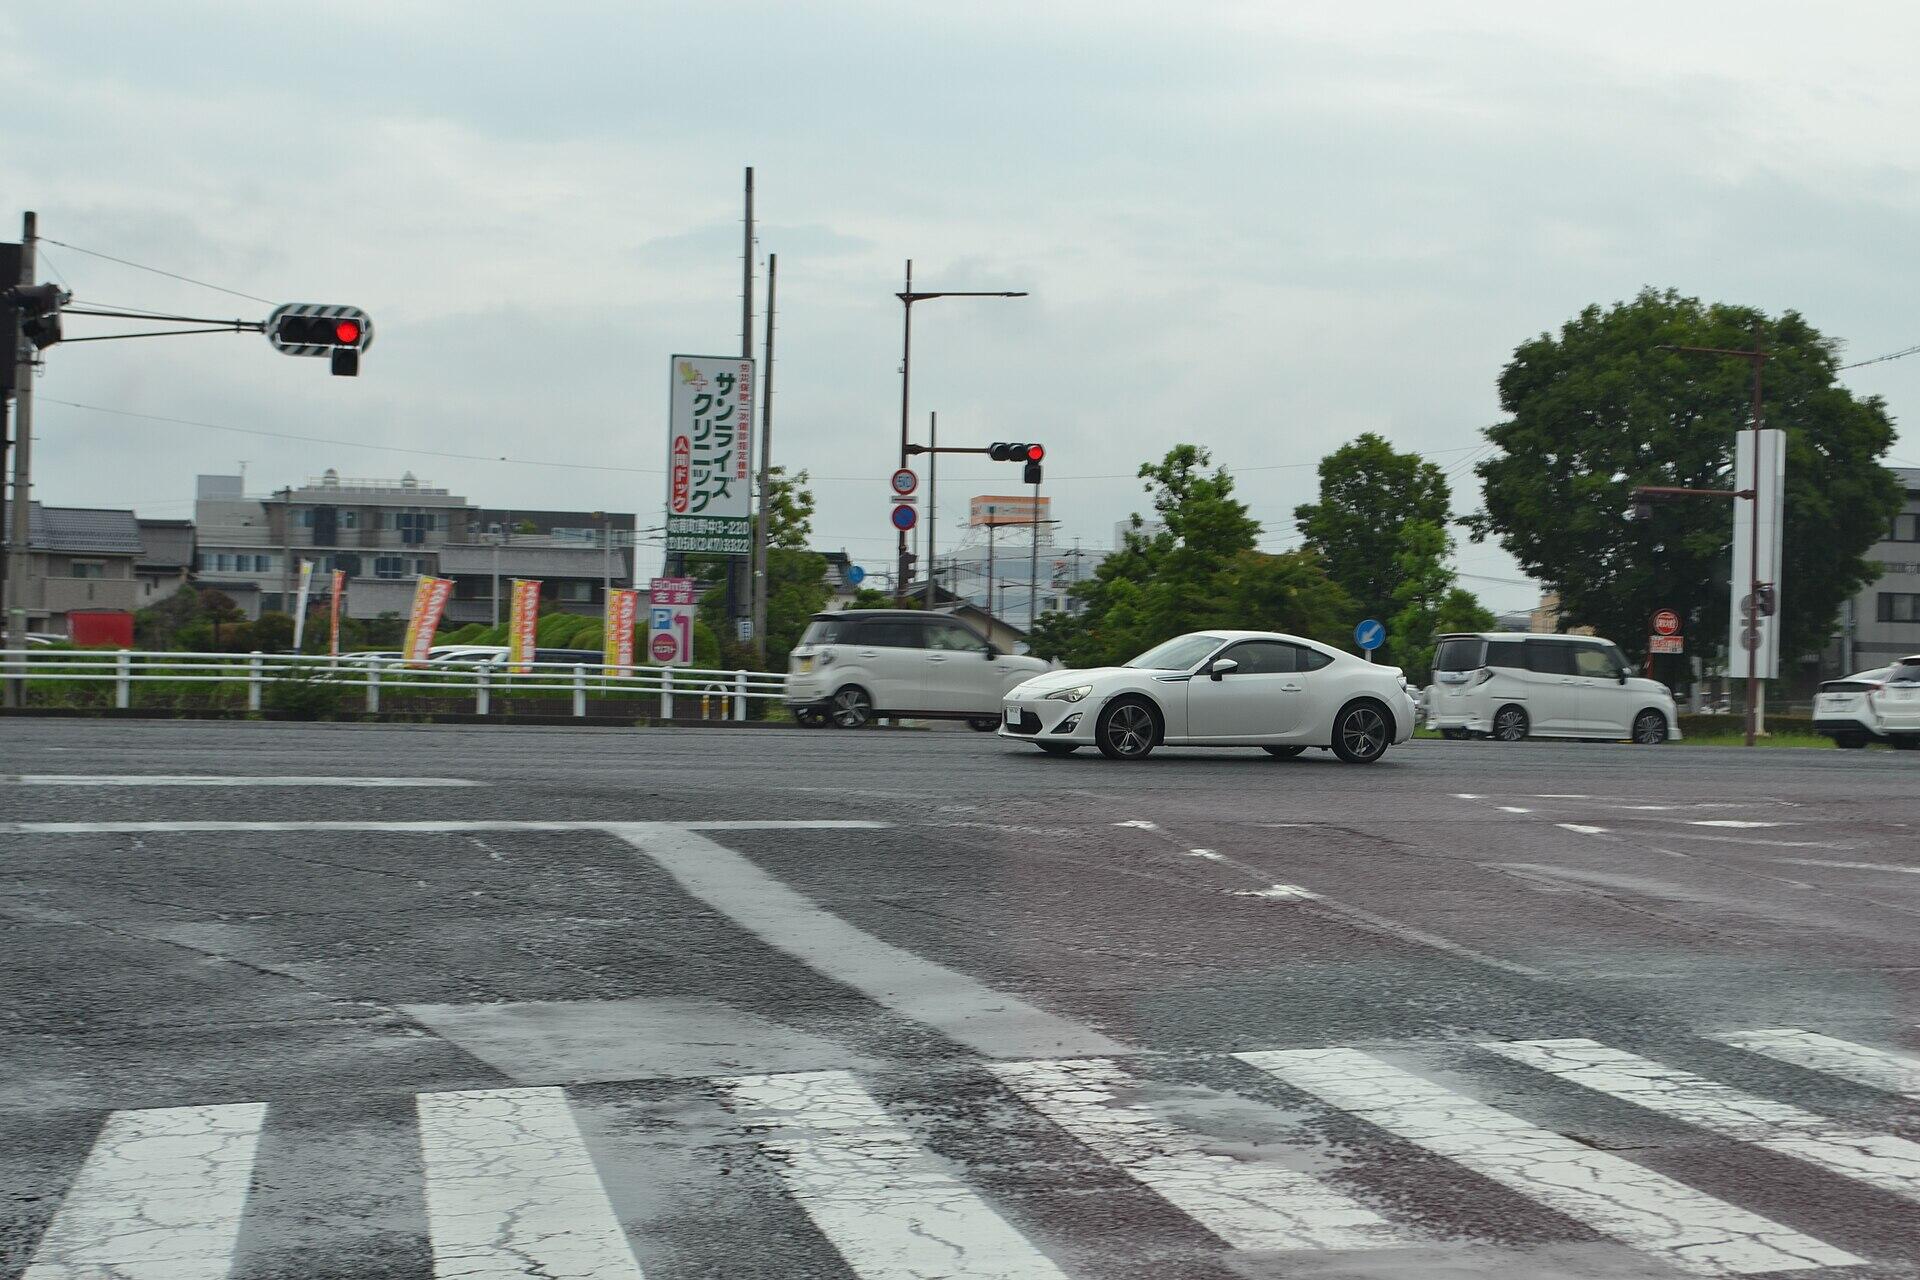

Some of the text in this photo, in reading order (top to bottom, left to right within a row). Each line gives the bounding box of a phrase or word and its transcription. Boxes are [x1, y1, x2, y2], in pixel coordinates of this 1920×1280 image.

[673, 439, 689, 510] 人間ドック
[691, 393, 714, 513] クリニック
[712, 372, 737, 499] サンライズ
